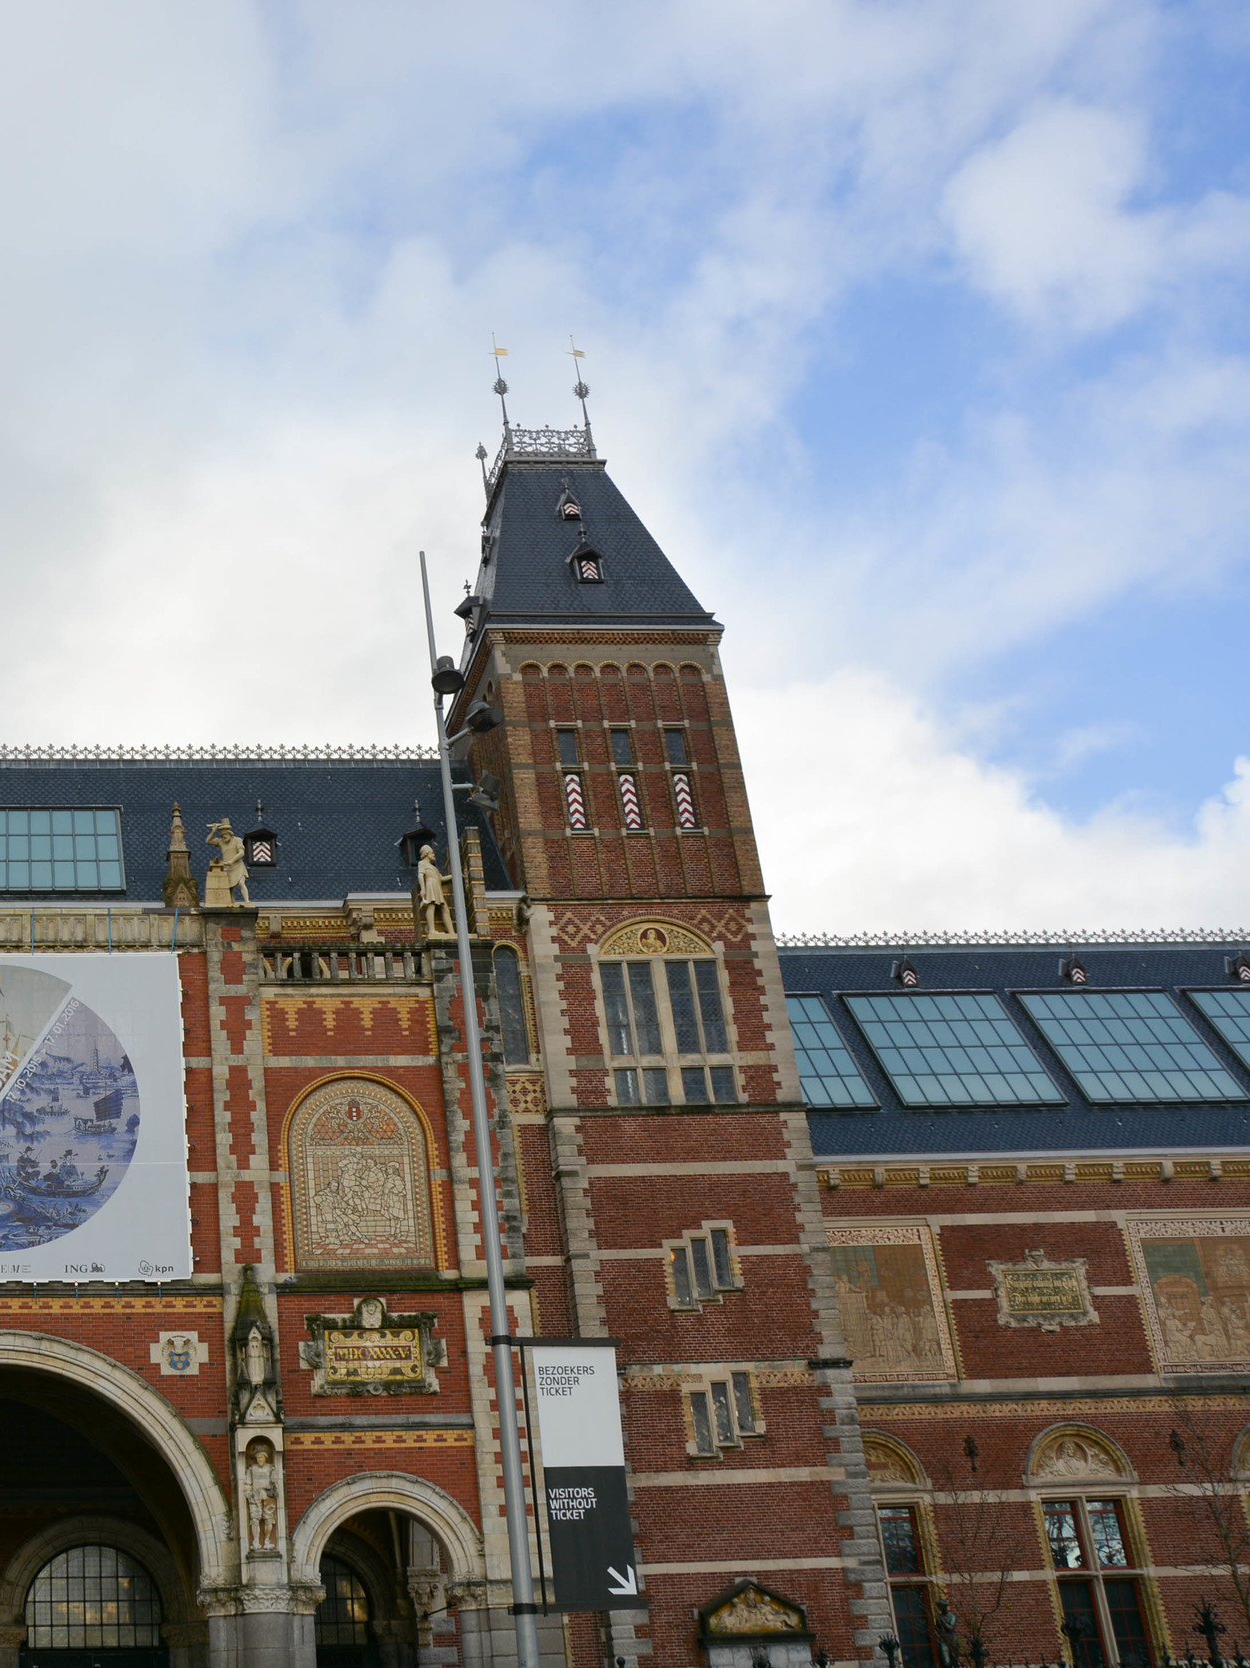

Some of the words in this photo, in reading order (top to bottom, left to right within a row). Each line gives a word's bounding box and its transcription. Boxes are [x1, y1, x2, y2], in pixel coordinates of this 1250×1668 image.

[64, 1264, 88, 1274] ING
[155, 1264, 174, 1274] kpn
[538, 1365, 595, 1376] BEZOEKERS
[538, 1376, 580, 1386] ZONDER
[539, 1386, 573, 1397] TICKET
[548, 1487, 595, 1499] VISITORS
[550, 1498, 598, 1510] WITHOUT
[550, 1509, 586, 1521] TICKET
